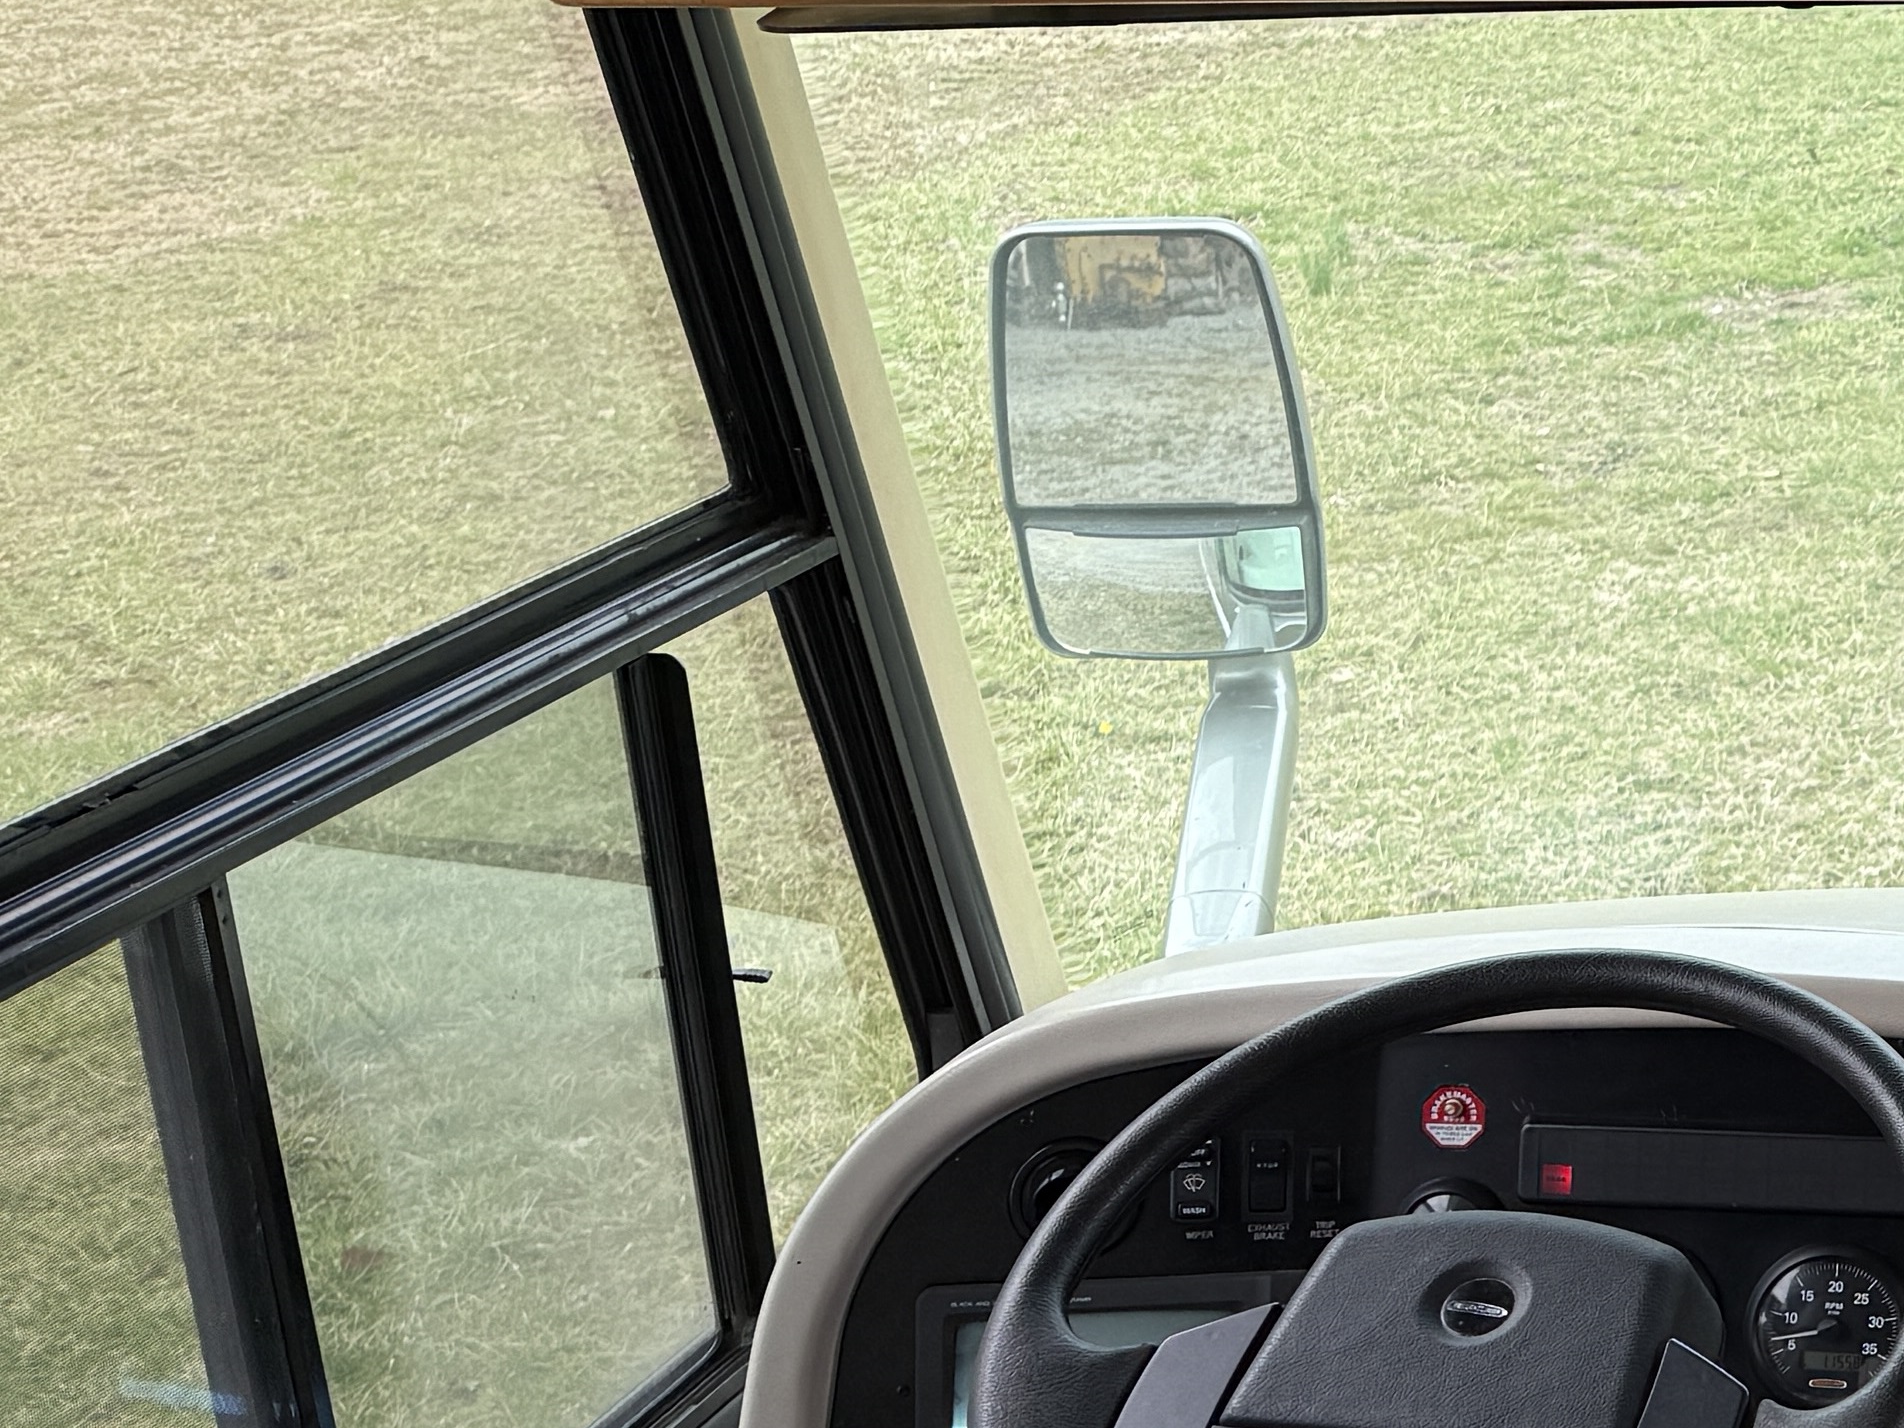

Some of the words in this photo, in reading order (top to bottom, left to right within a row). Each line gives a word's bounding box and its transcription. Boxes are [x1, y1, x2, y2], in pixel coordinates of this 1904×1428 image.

[1827, 1280, 1844, 1293] 20
[1800, 1289, 1815, 1302] 15
[1853, 1292, 1870, 1305] 25
[1784, 1311, 1798, 1324] 10
[1868, 1315, 1885, 1329] 30
[1787, 1339, 1797, 1351] 5
[1861, 1342, 1878, 1356] 35
